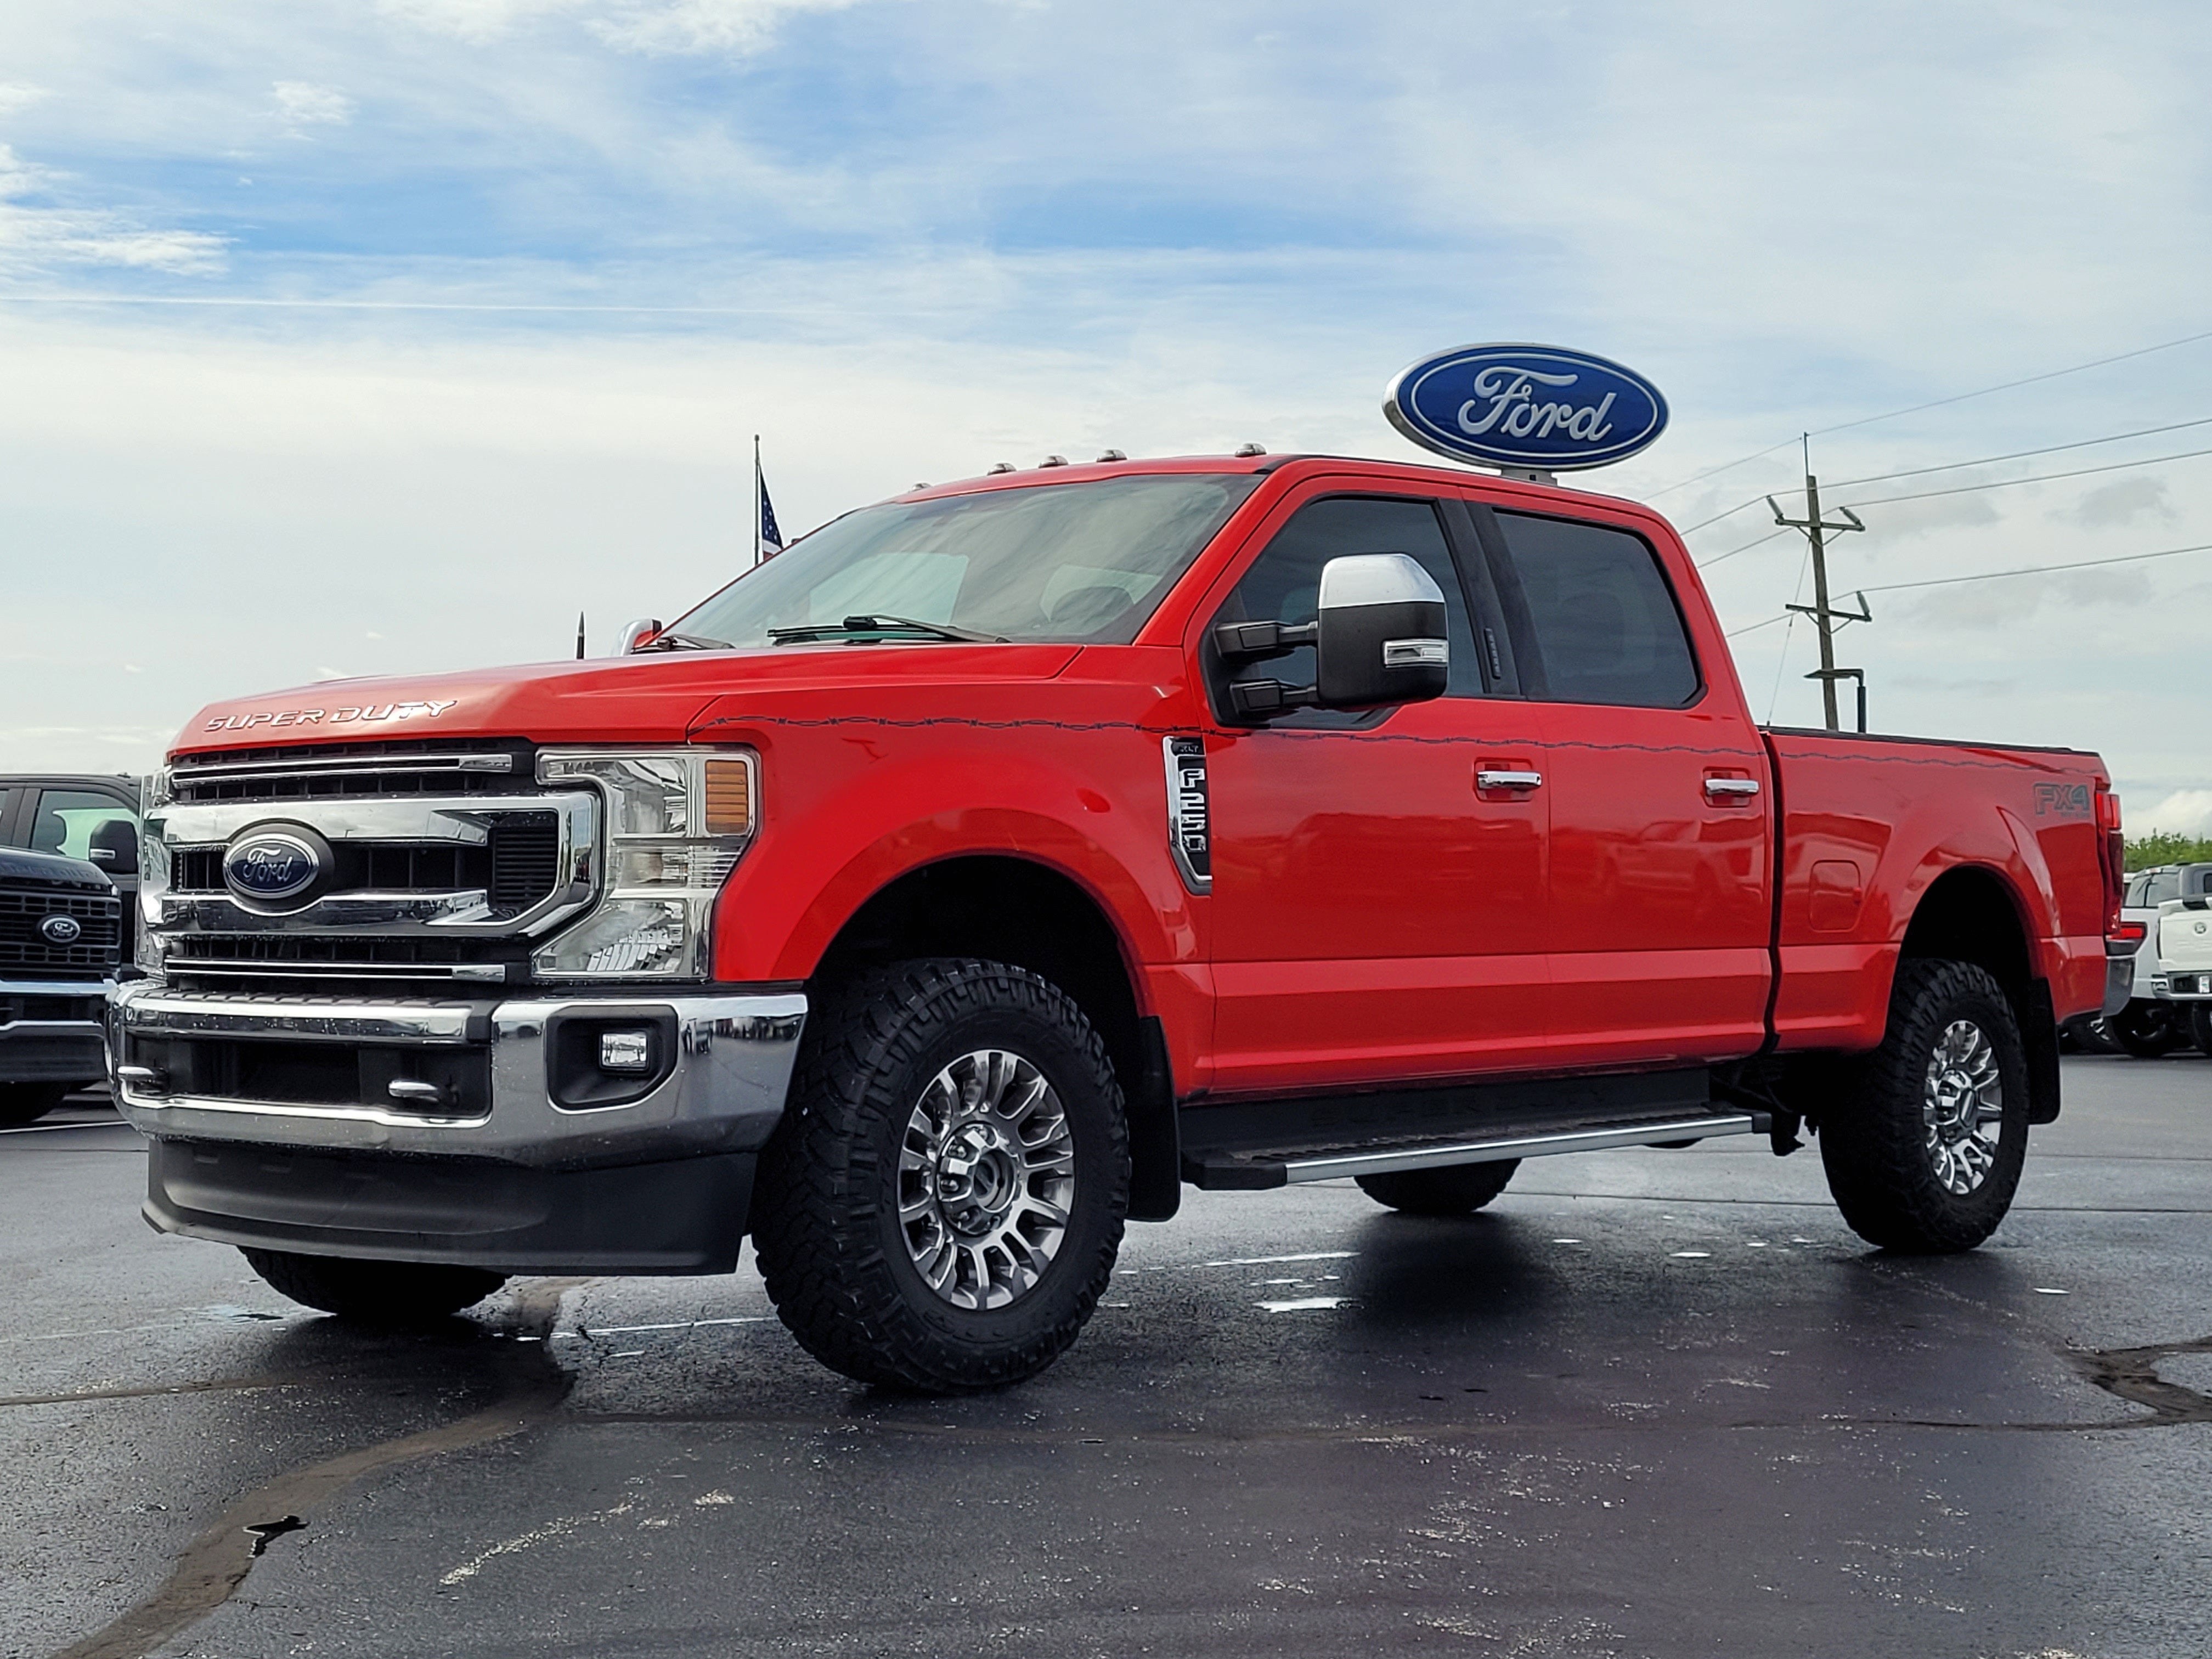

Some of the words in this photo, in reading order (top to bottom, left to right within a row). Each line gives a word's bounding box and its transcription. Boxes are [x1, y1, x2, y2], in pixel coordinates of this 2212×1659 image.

[1457, 366, 1617, 441] Ford
[204, 708, 327, 732] SUPER
[329, 699, 458, 723] DUTY
[2033, 782, 2090, 815] FX4
[242, 847, 293, 882] Ford
